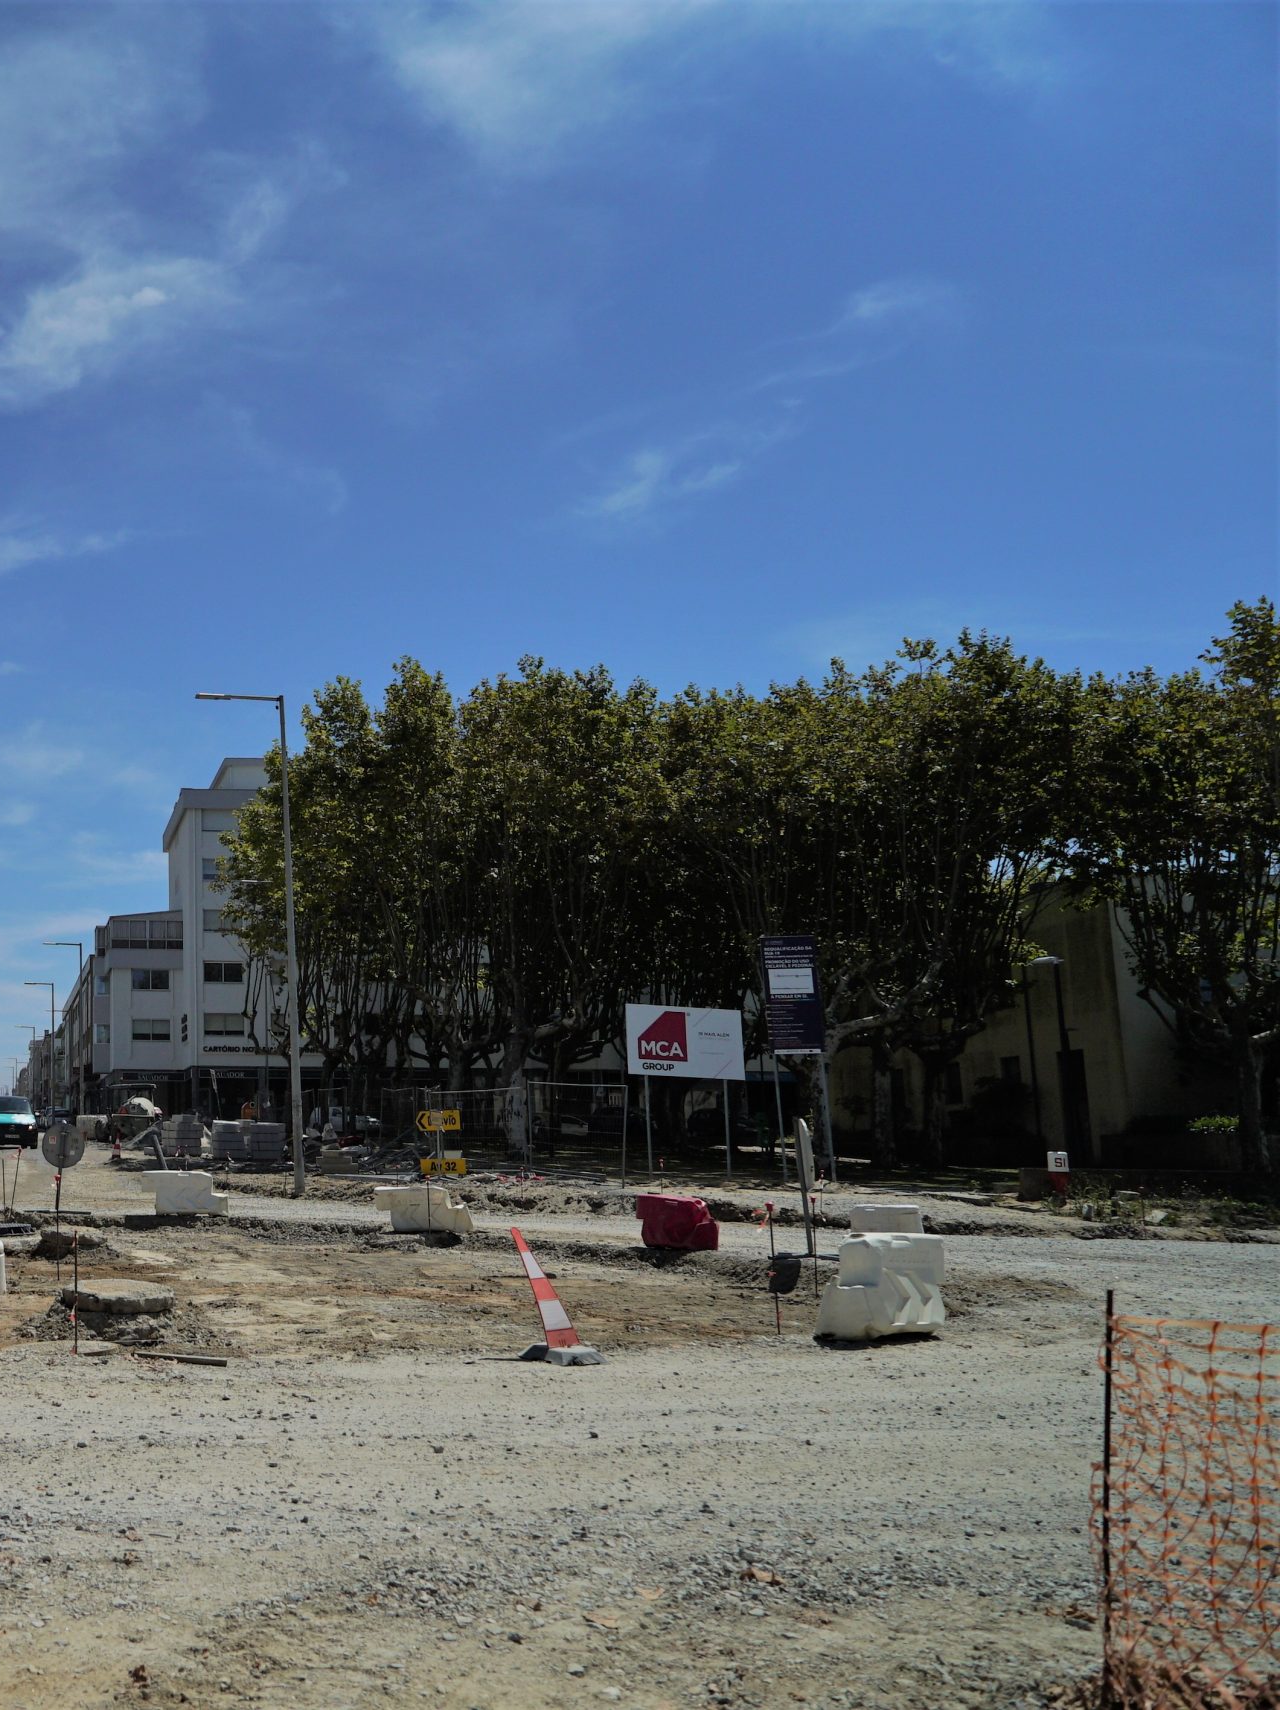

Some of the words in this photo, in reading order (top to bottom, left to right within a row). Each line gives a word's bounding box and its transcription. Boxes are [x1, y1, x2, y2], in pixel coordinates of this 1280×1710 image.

[203, 1044, 240, 1053] CARTÓRIO
[640, 1040, 684, 1058] MCA
[642, 1062, 675, 1071] GROUP
[445, 1162, 457, 1171] 32
